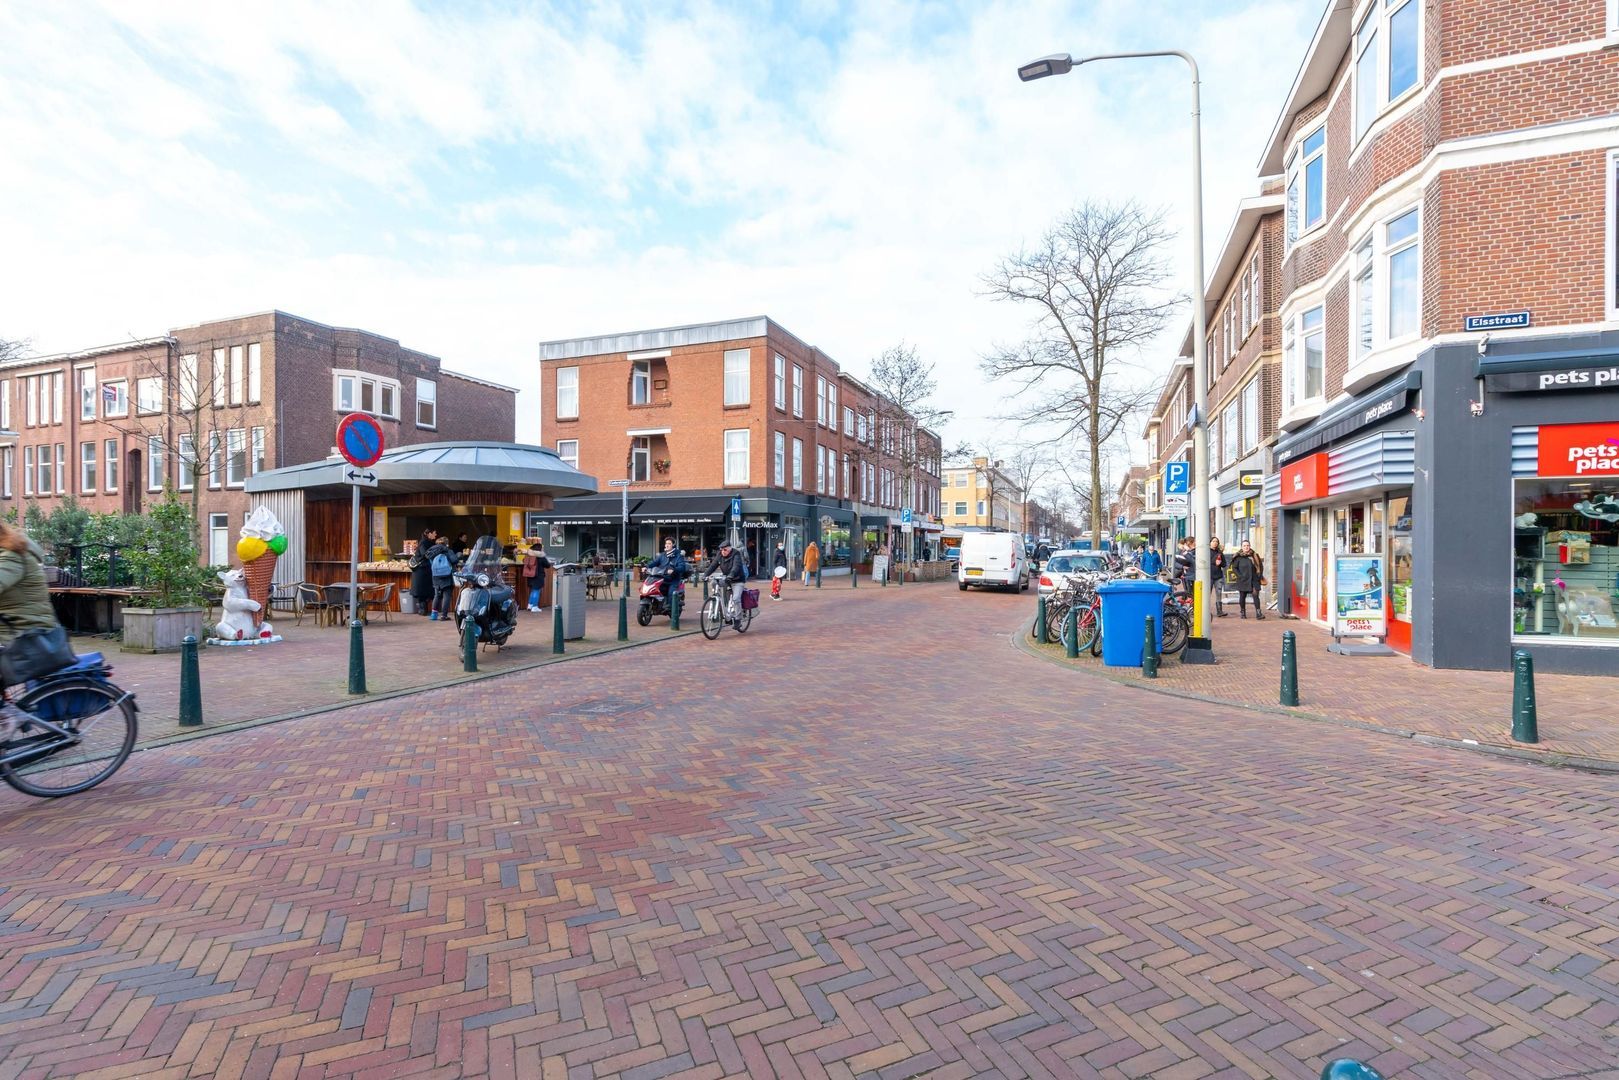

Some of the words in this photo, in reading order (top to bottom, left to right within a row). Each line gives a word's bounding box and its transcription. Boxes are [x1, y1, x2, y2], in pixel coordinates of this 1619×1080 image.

[1472, 315, 1524, 327] Elsstraat
[1539, 370, 1590, 390] pets
[1595, 368, 1619, 386] pl
[1365, 406, 1377, 423] pets
[1377, 400, 1393, 418] place
[1568, 444, 1618, 462] pets
